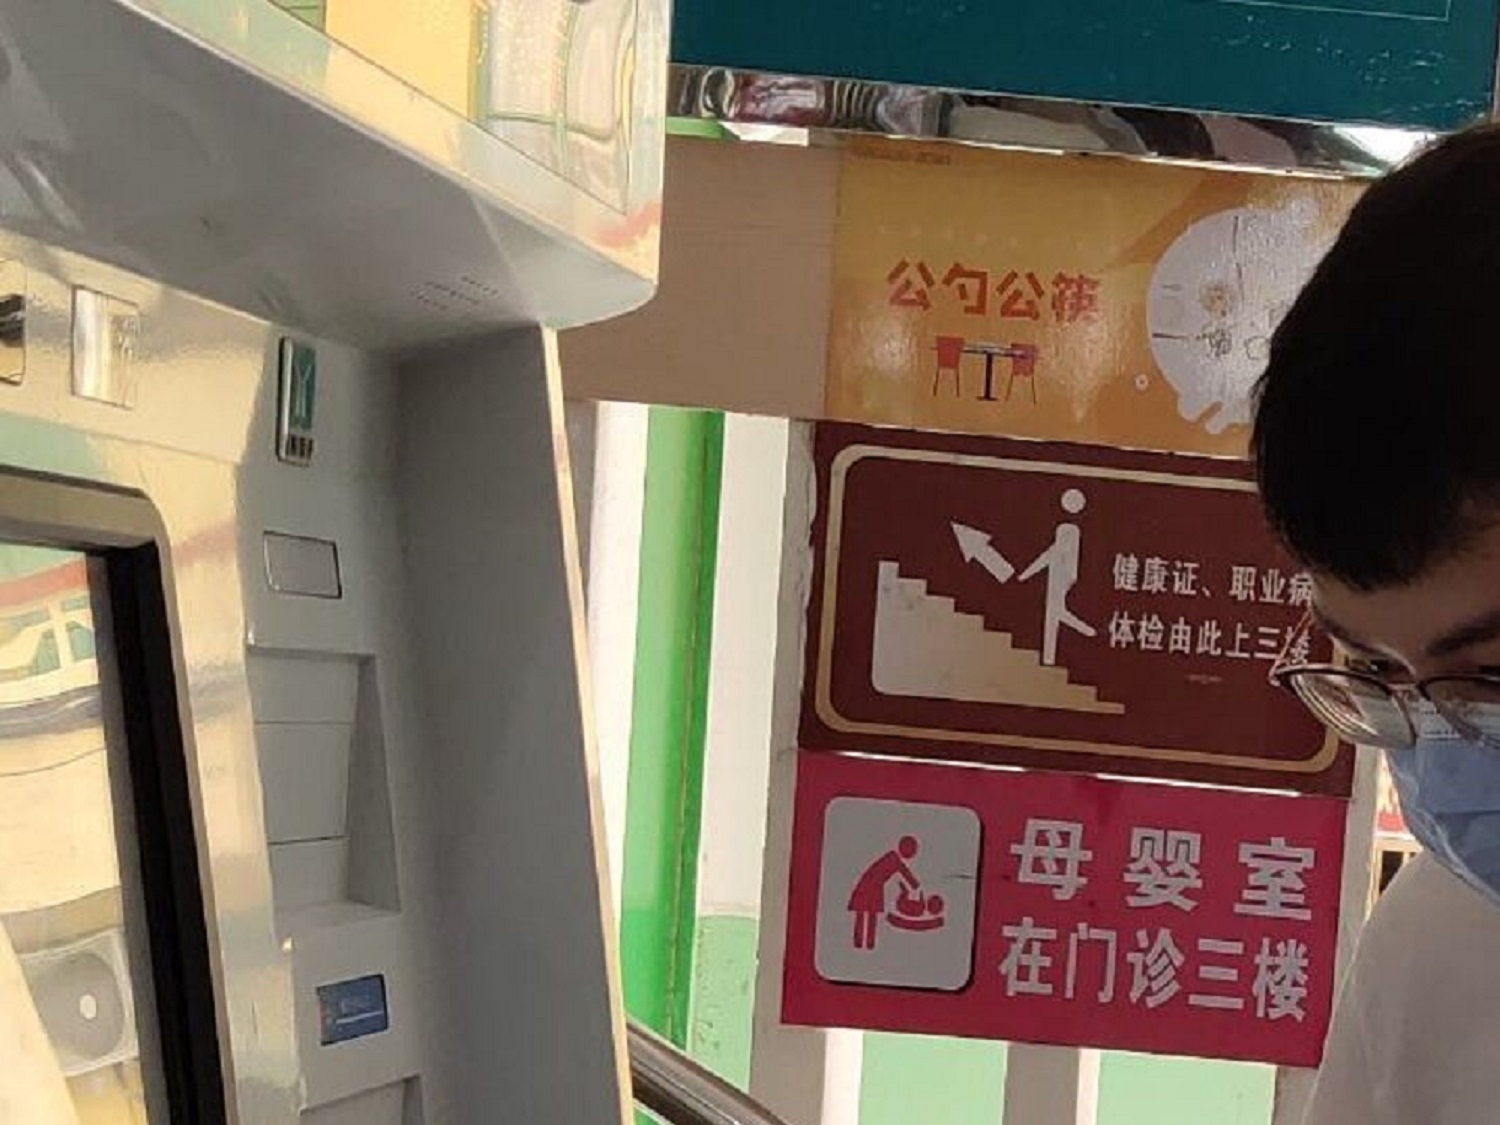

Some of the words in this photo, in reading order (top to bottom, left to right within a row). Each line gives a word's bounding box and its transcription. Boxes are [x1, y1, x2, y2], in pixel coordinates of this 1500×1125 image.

[1113, 553, 1313, 606] 健康证、职业病
[1010, 818, 1315, 921] 母婴室
[999, 917, 1309, 1022] 在门诊三楼
